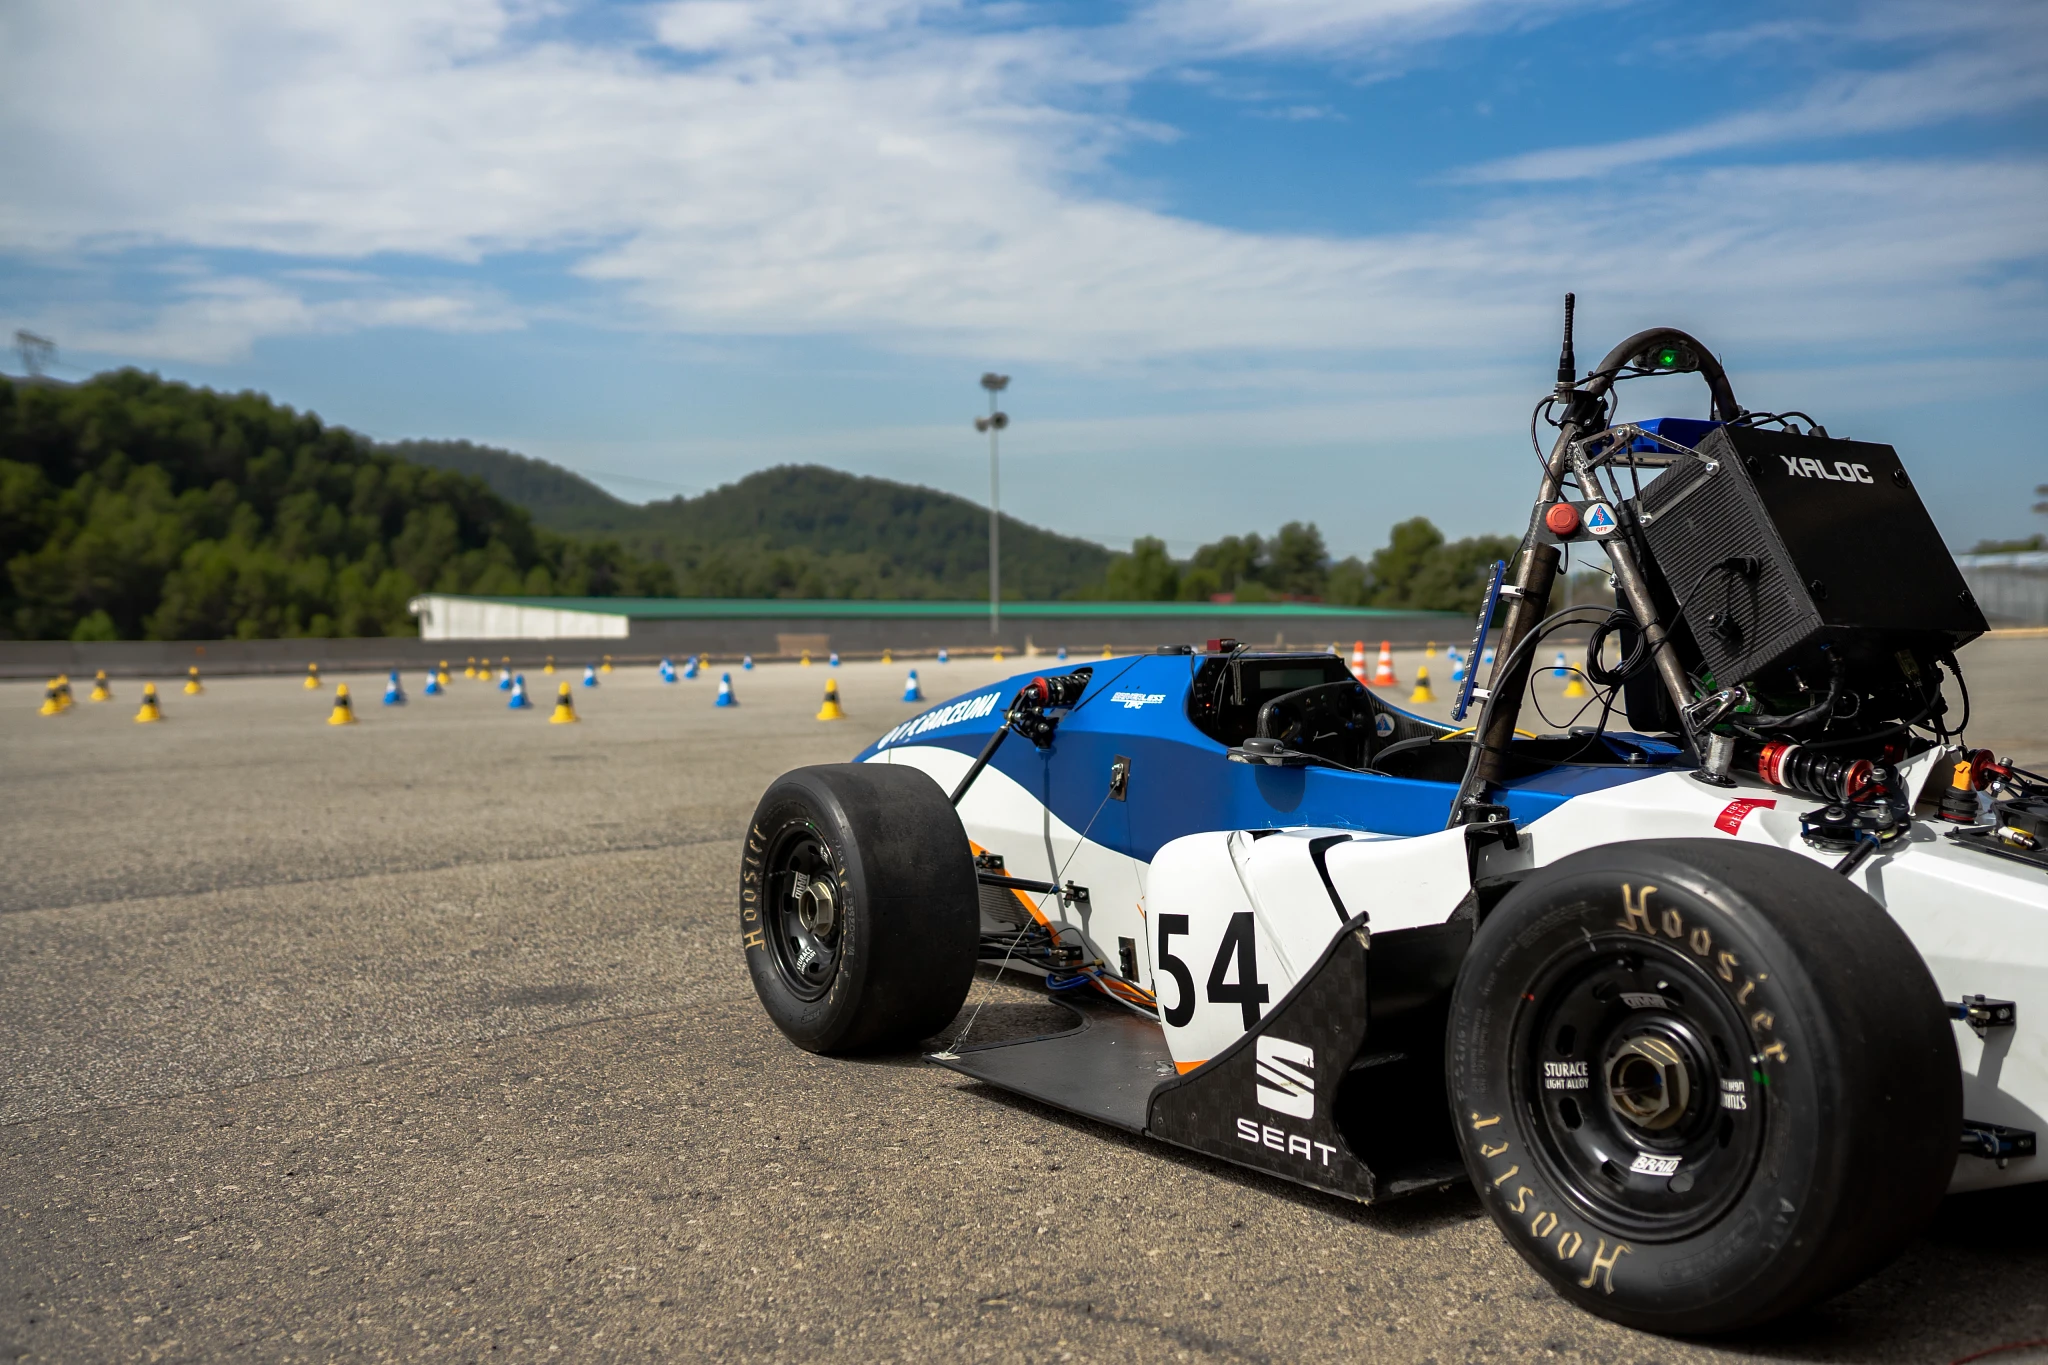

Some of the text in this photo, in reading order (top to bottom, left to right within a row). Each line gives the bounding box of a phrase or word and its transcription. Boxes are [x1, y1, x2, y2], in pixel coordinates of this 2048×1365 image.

[1779, 455, 1875, 484] XALOC
[1158, 911, 1270, 1032] 54
[1616, 883, 1788, 1064] Hoosier
[1544, 1061, 1588, 1077] STURACE
[1545, 1077, 1590, 1089] LIGHT ALLOY
[1236, 1117, 1337, 1167] SEAT
[1631, 1156, 1680, 1173] BRAID
[1471, 1112, 1633, 1295] Hoosier
